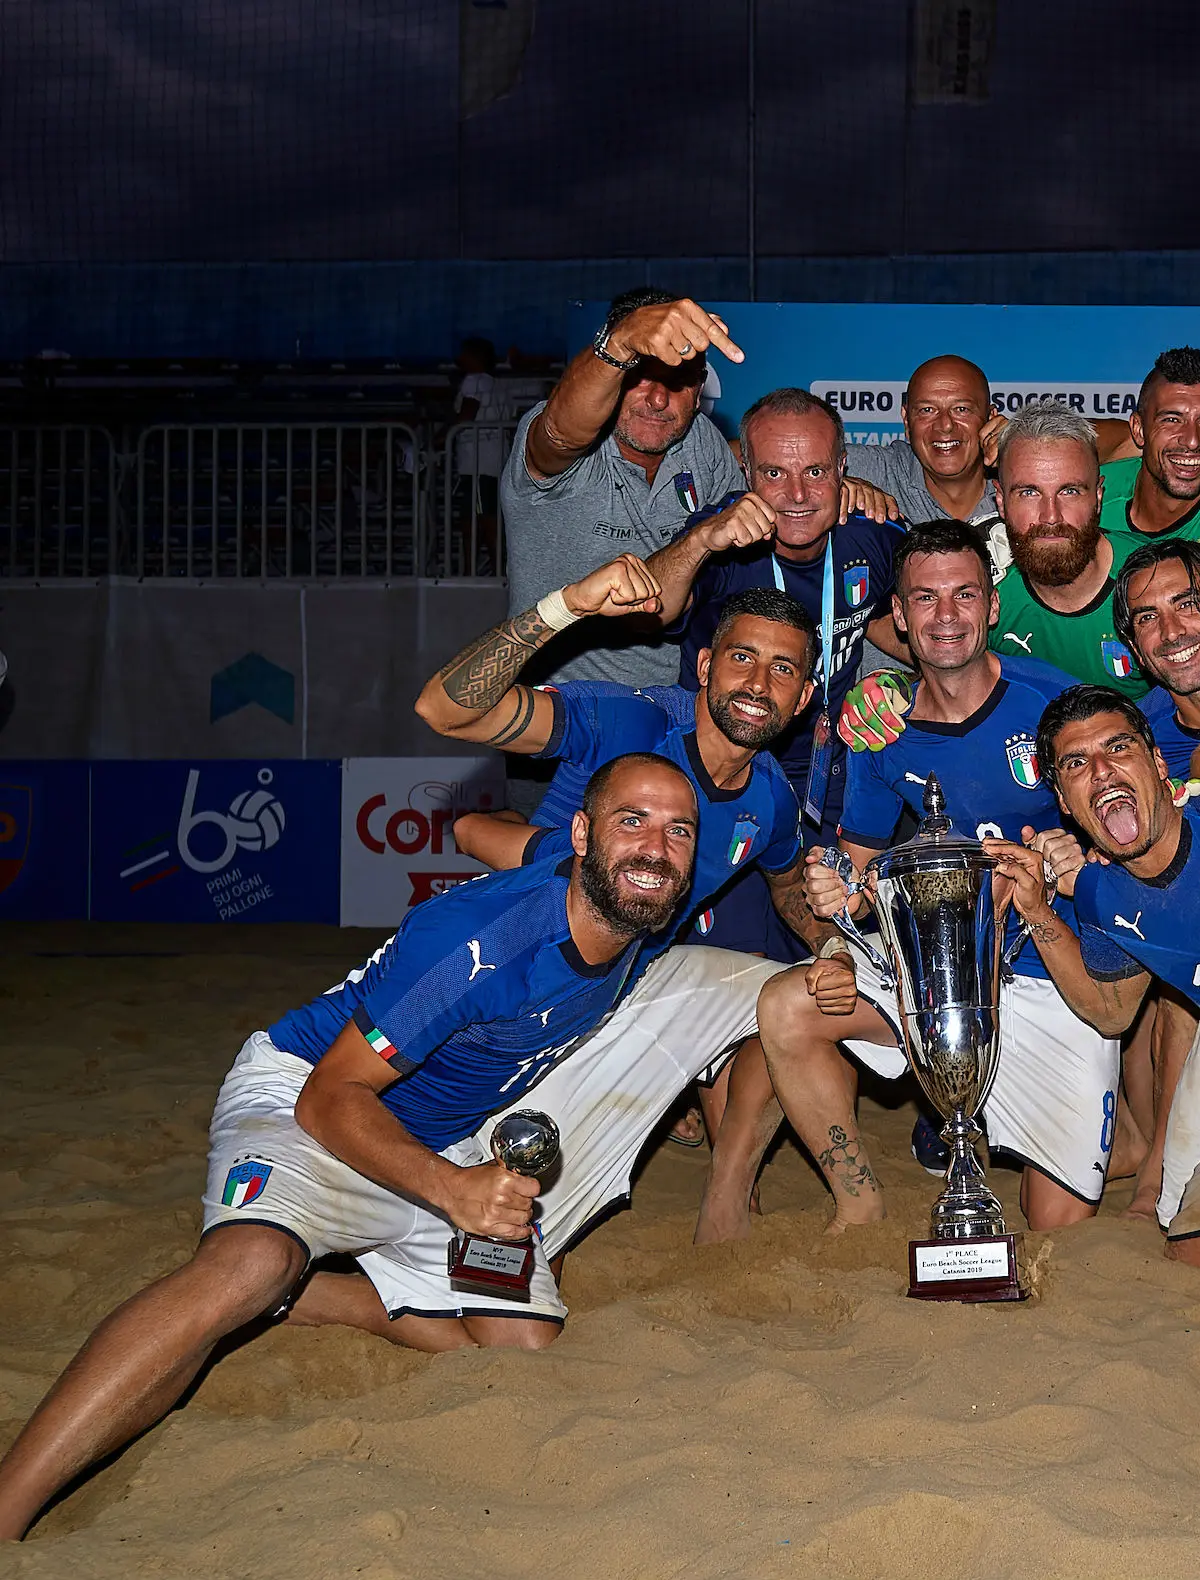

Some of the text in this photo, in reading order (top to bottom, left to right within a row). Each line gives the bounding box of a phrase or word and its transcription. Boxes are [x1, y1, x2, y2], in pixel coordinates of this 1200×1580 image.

[825, 391, 893, 412] EURO
[1093, 393, 1140, 413] LEA
[609, 527, 632, 539] TIM
[206, 867, 242, 894] PRIMI
[213, 873, 263, 908] SU OGNI
[218, 884, 276, 921] PALLONE
[1100, 1090, 1115, 1153] 8
